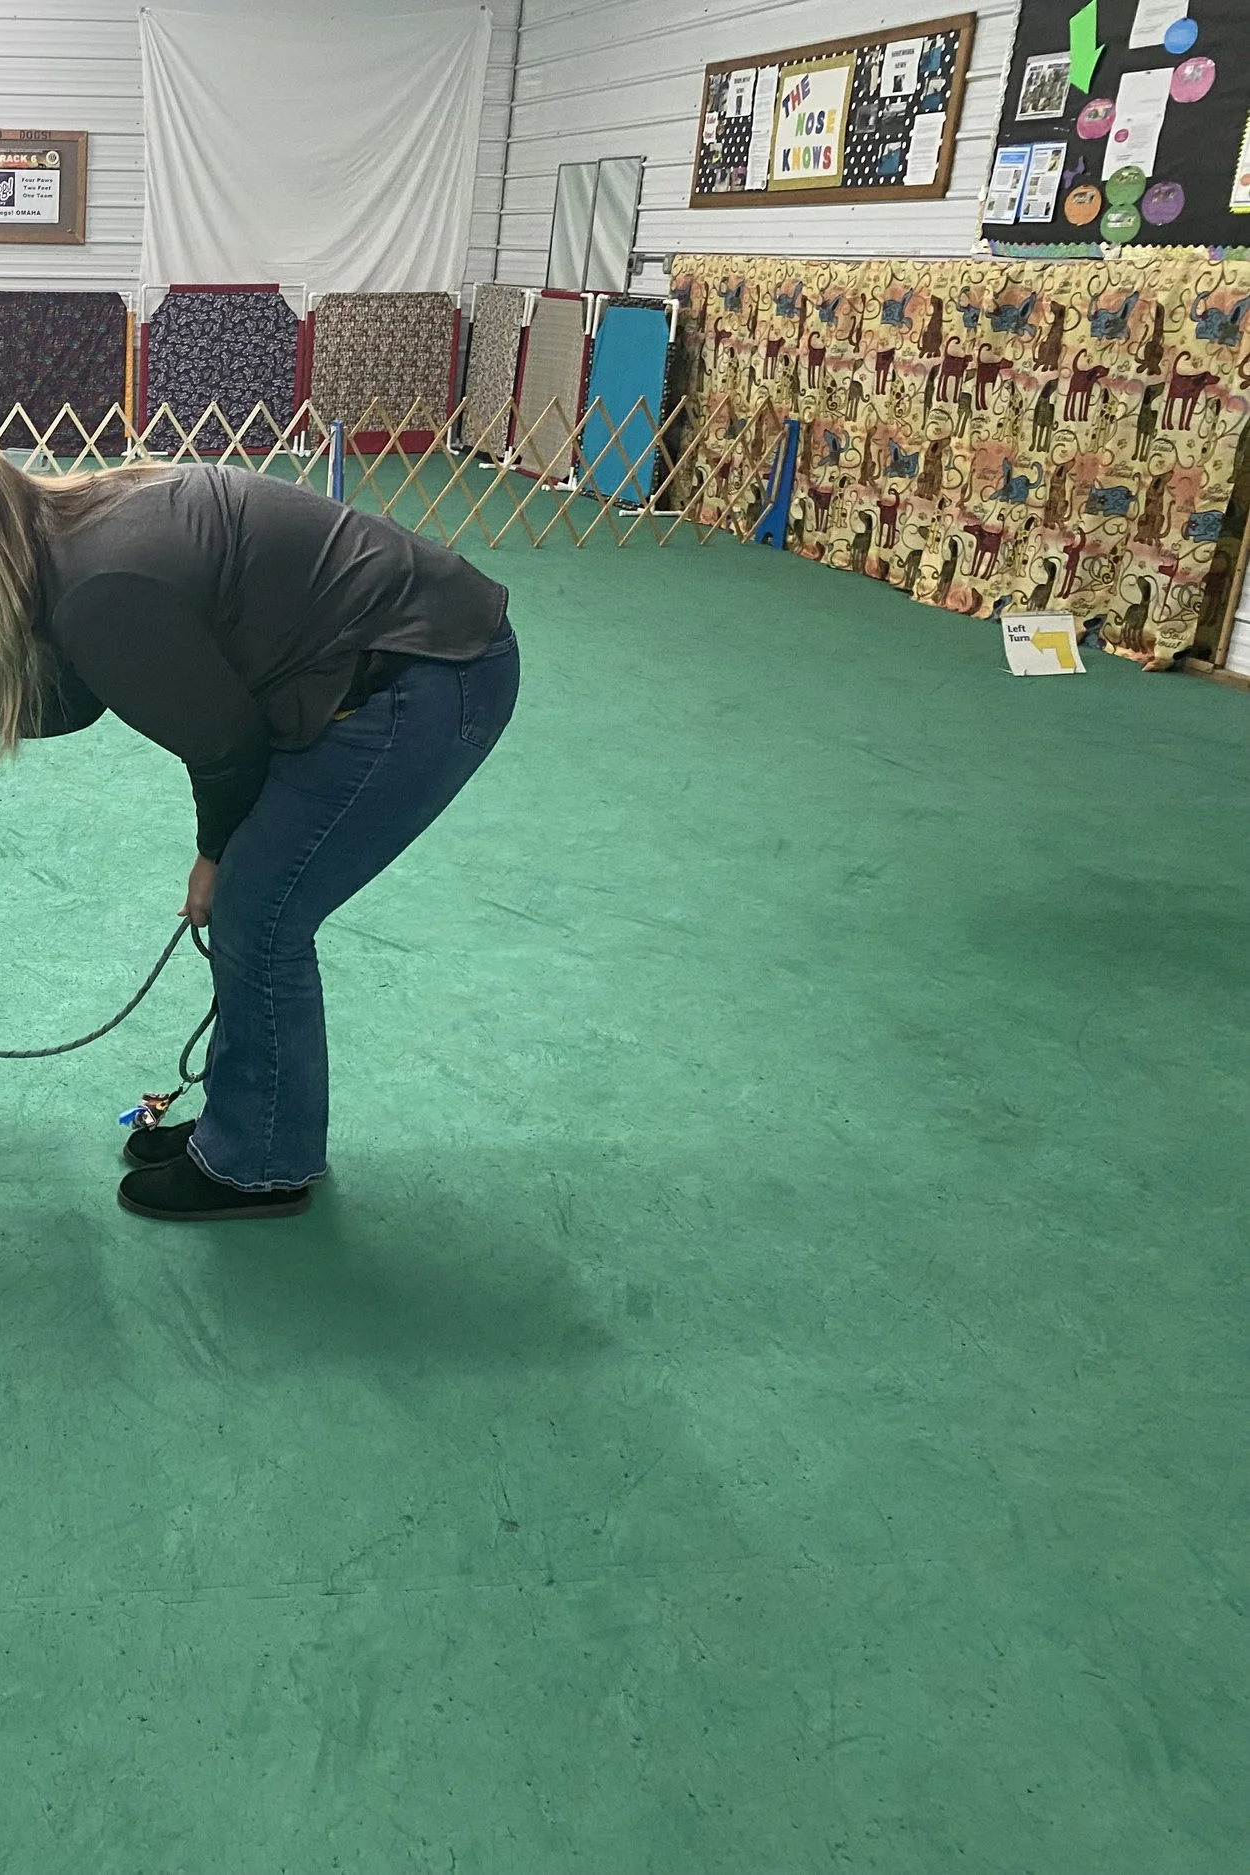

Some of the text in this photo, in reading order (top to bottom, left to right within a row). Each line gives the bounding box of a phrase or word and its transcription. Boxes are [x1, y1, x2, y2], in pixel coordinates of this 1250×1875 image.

[782, 74, 811, 118] THE
[795, 109, 837, 136] NOSE
[30, 155, 37, 163] 6
[782, 146, 832, 171] KNOWS
[1007, 624, 1026, 633] Left
[1008, 634, 1030, 642] Turn
